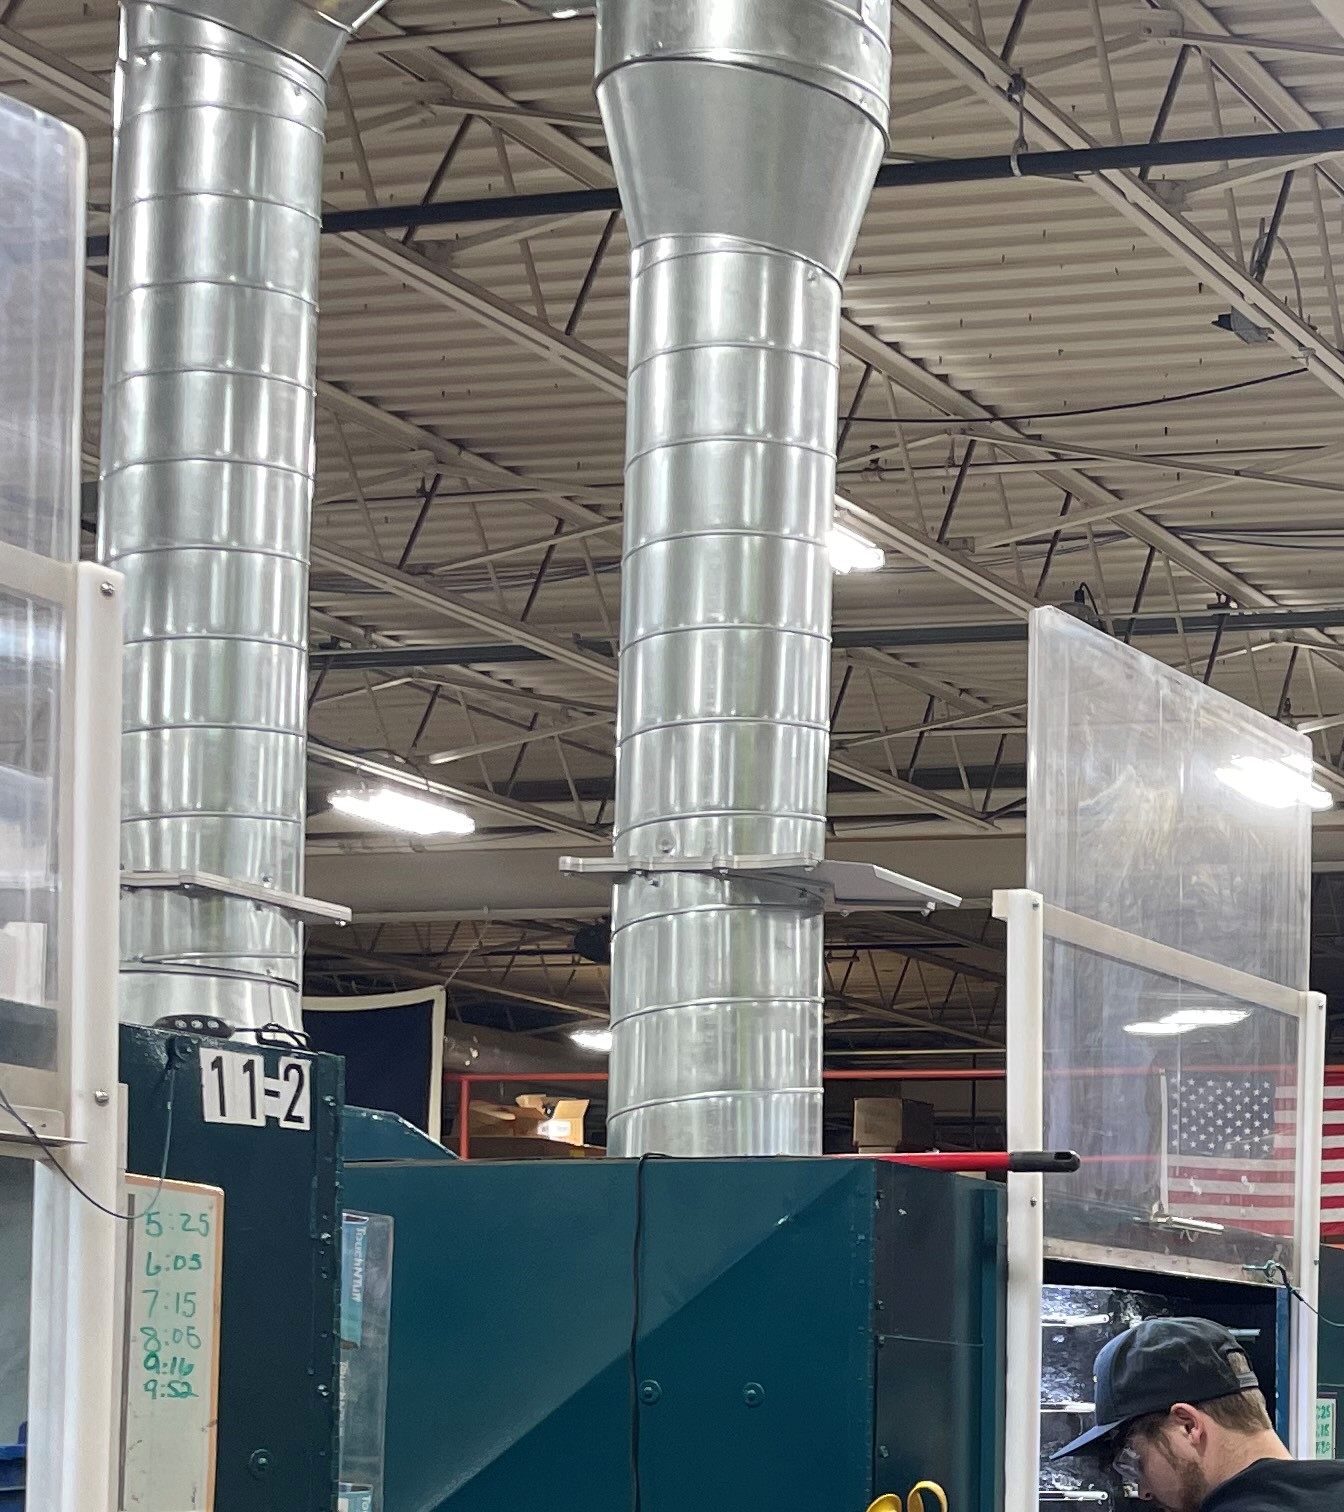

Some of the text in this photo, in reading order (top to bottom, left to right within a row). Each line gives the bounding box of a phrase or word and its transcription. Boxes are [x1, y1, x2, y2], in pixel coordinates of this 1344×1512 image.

[211, 1055, 305, 1123] 11-2
[145, 1211, 210, 1237] 5:25
[142, 1289, 197, 1318] 7:15
[140, 1326, 202, 1353] 8:05
